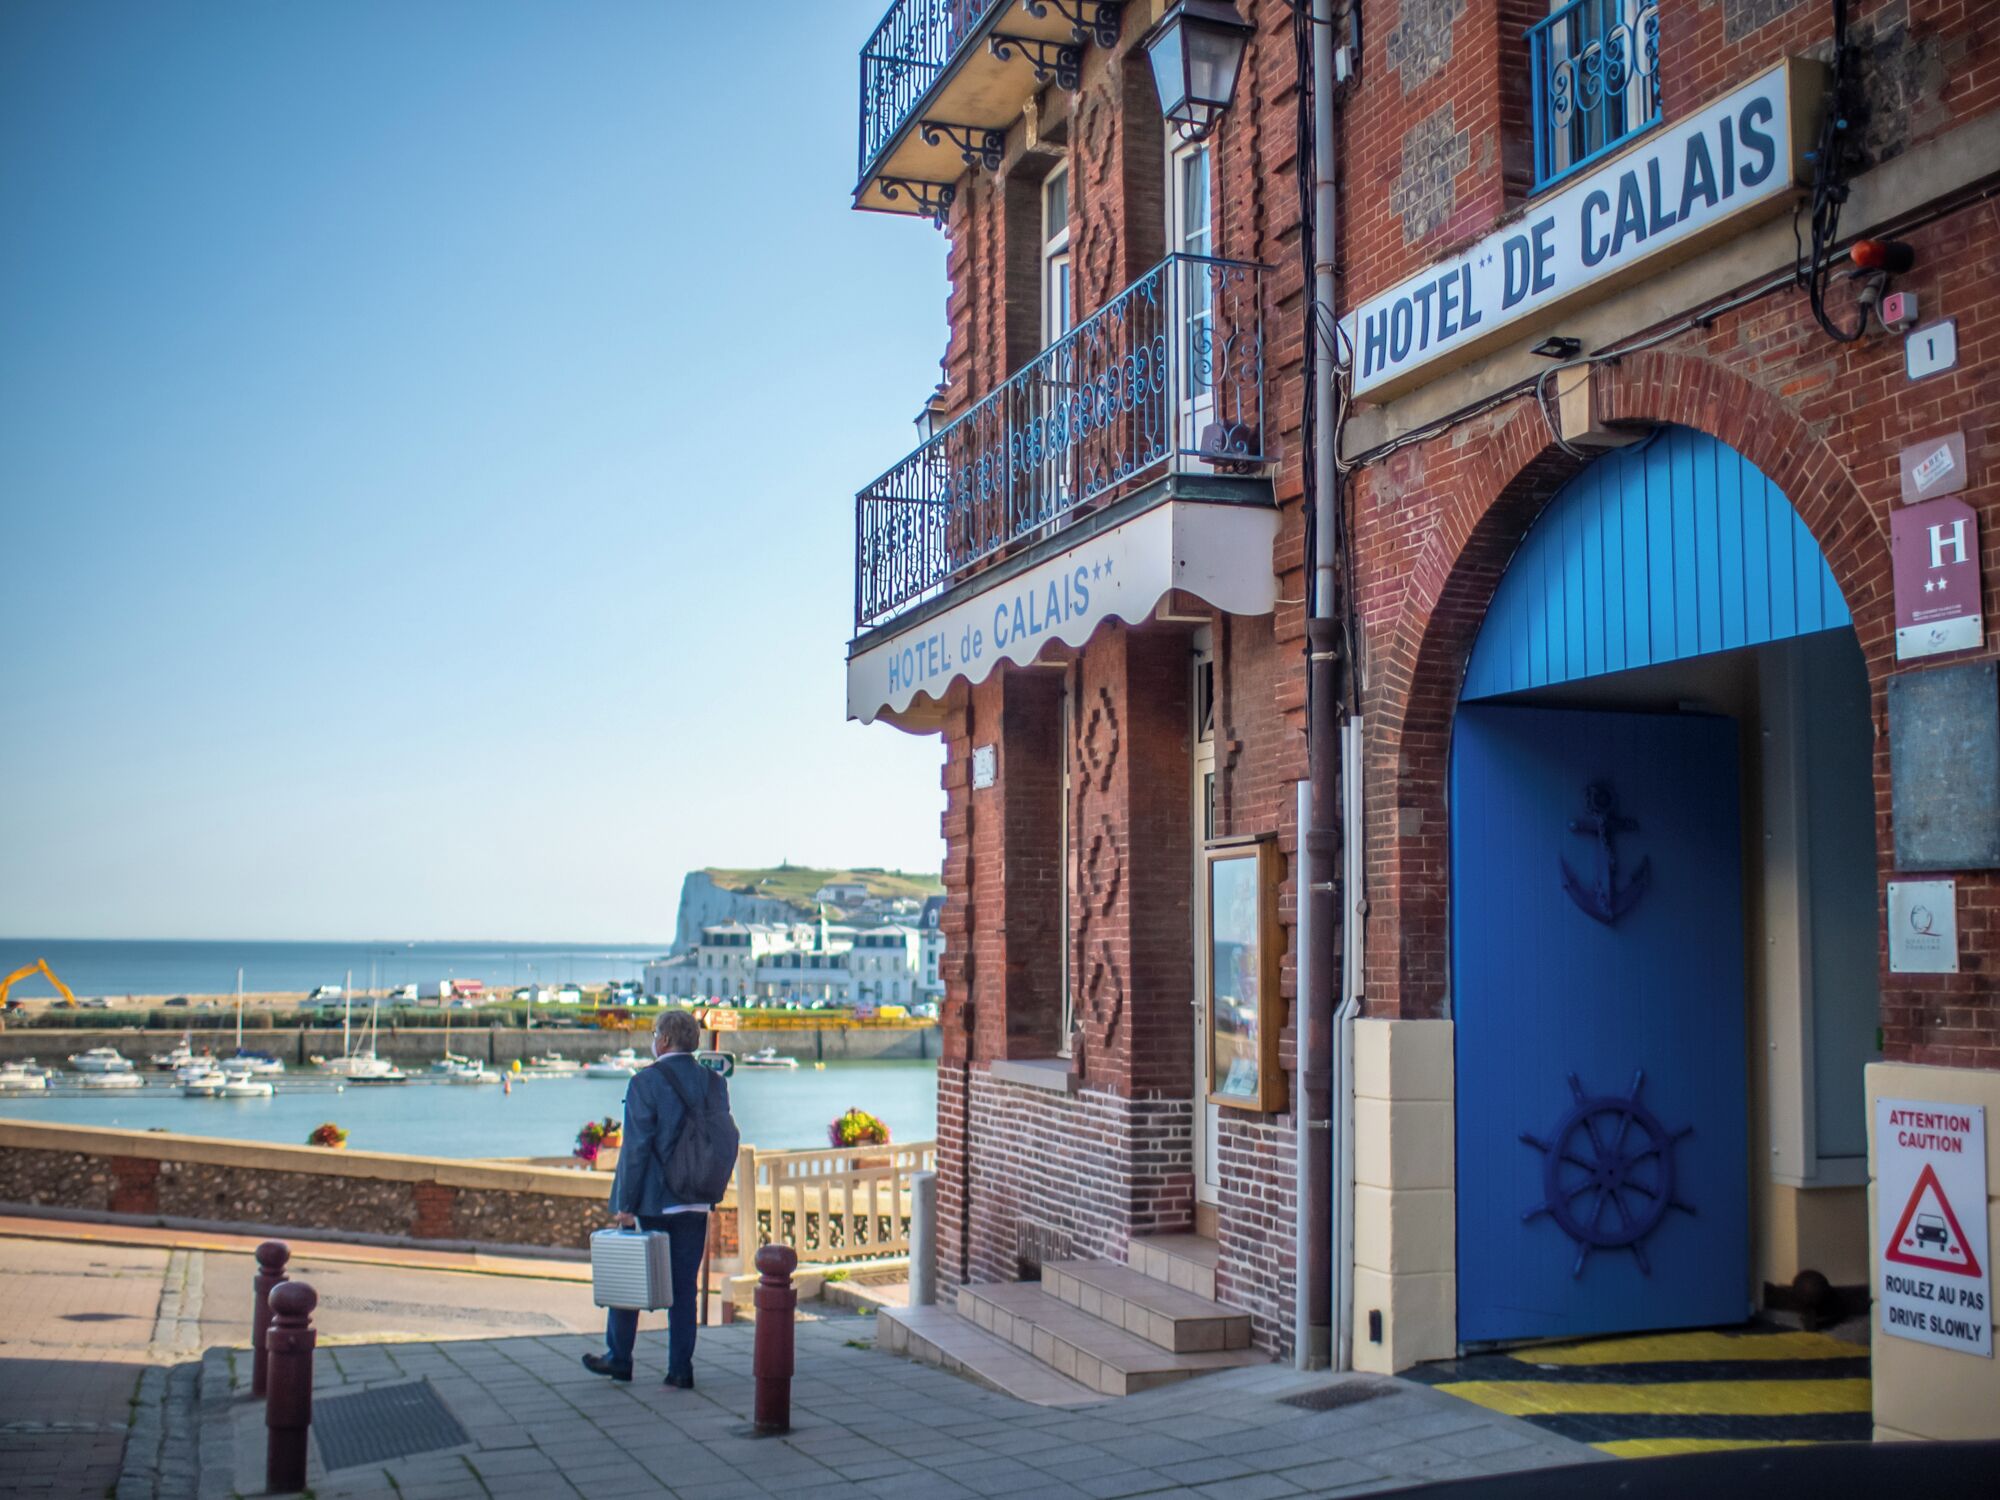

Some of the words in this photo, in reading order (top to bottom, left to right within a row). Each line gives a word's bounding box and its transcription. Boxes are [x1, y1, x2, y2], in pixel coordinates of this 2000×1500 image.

[1363, 262, 1482, 378] HOTEL
[1501, 215, 1556, 311] DE
[1580, 96, 1776, 268] CALAIS
[1927, 338, 1934, 361] 1
[1926, 518, 1970, 569] H
[889, 632, 951, 694] HOTEL
[960, 624, 983, 664] de
[993, 565, 1089, 649] CALAIS
[1889, 1109, 1970, 1133] ATTENTION
[1898, 1130, 1963, 1153] CAUTION
[1885, 1274, 1935, 1301] ROULEZ
[1938, 1285, 1956, 1305] AU
[1959, 1288, 1984, 1311] PAS
[1889, 1306, 1926, 1331] DRIVE
[1929, 1314, 1981, 1342] SLOWLY
